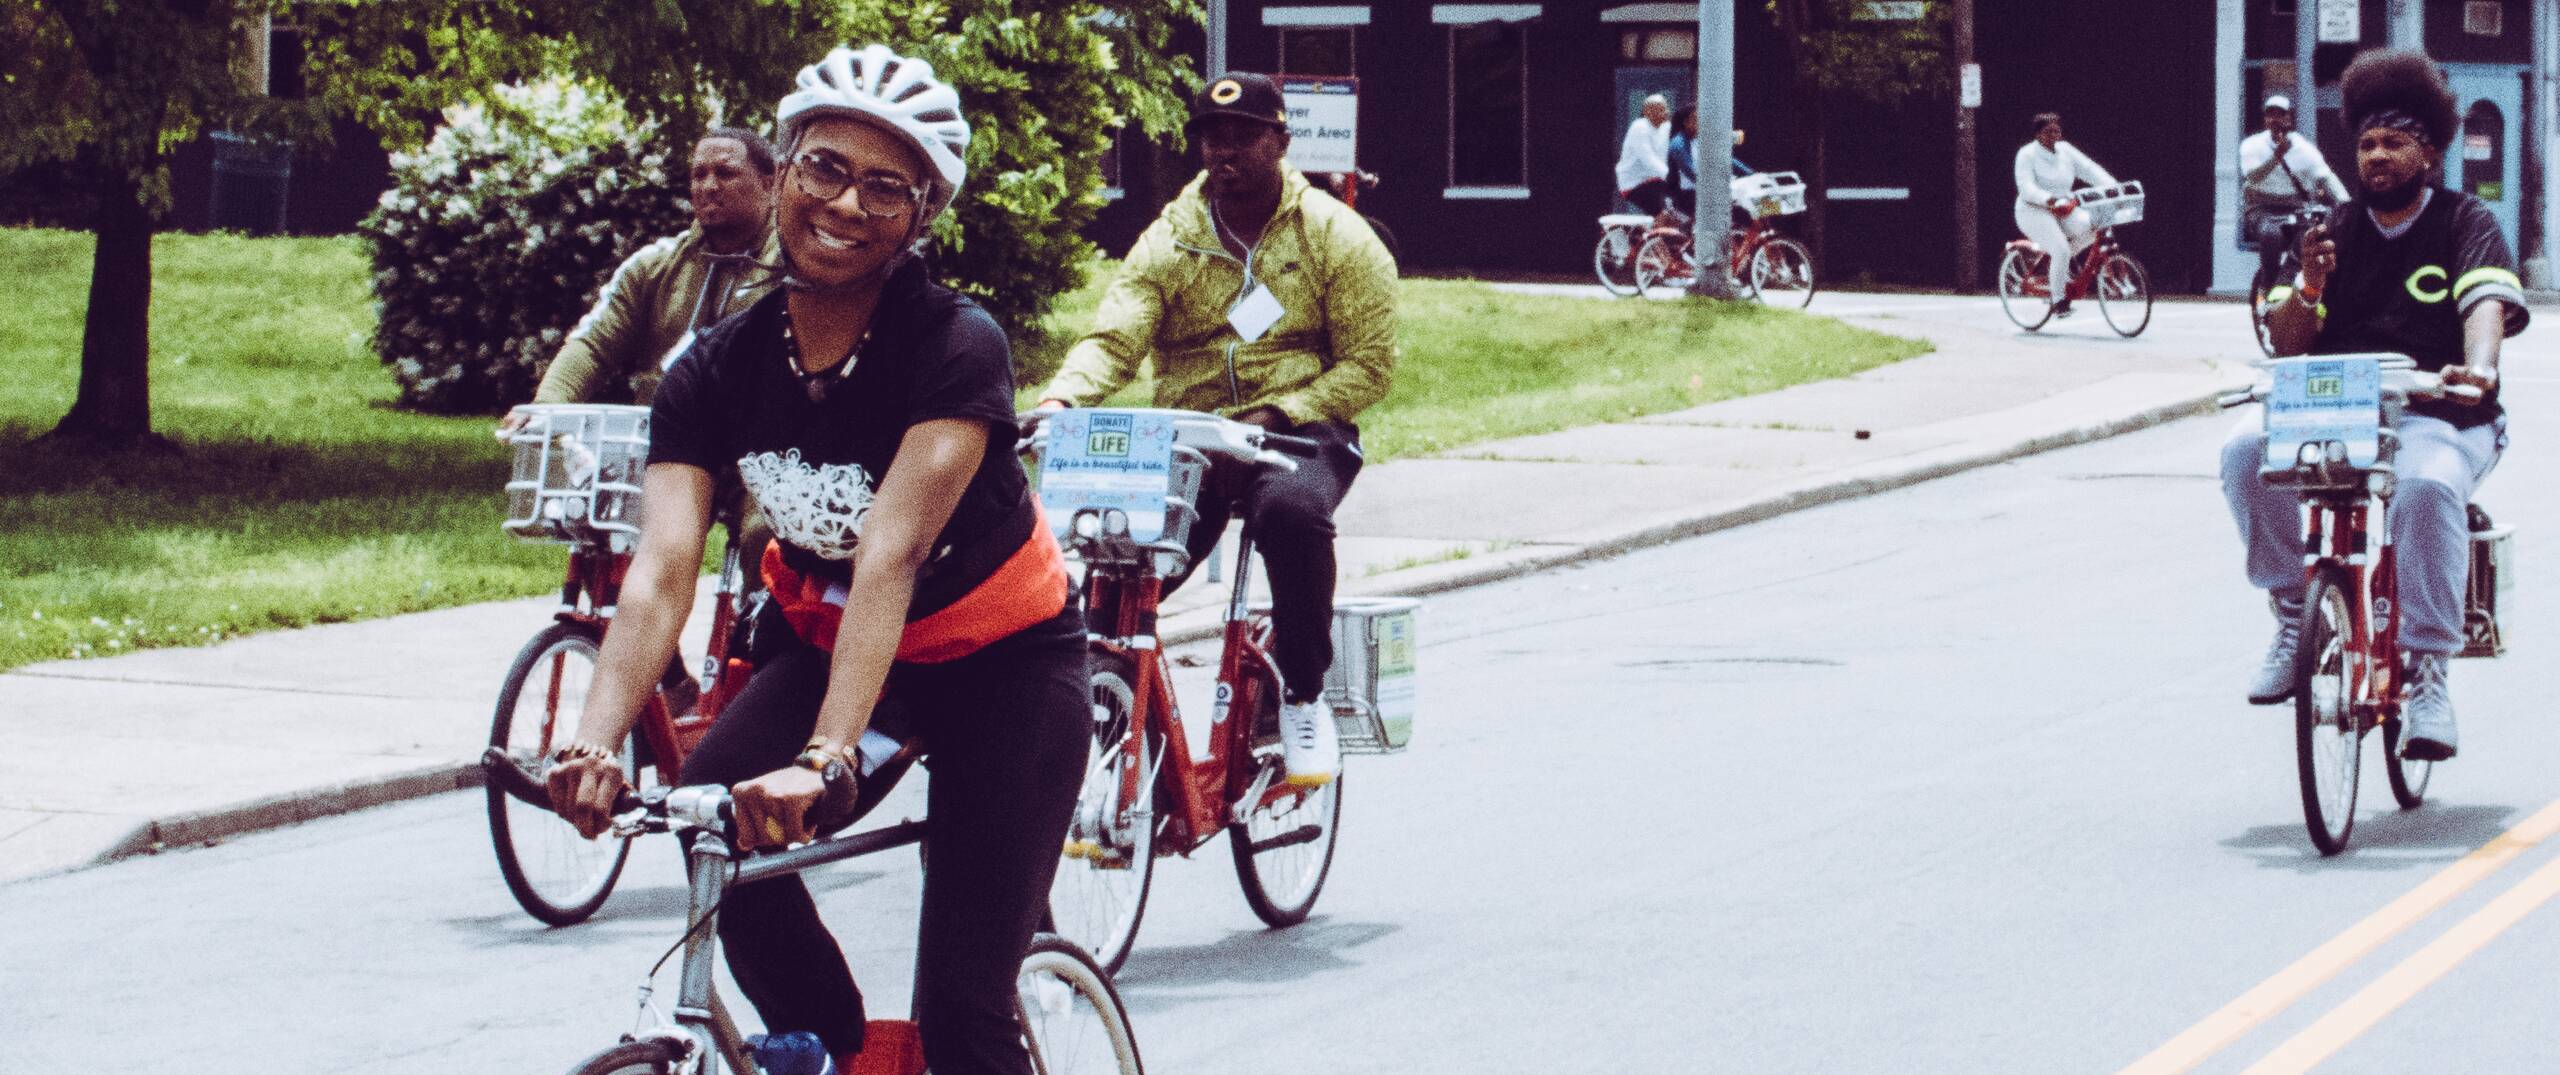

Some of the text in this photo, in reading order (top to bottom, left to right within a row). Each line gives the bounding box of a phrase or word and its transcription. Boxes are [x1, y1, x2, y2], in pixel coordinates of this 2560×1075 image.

[1285, 107, 1311, 120] yer
[1317, 126, 1351, 139] Area
[2404, 264, 2449, 304] C
[2309, 379, 2340, 394] LIFE
[1092, 416, 1129, 428] DONATE
[1091, 435, 1127, 453] LIFE
[1049, 457, 1068, 472] Life
[1071, 458, 1080, 467] is
[1092, 459, 1139, 473] beautiful
